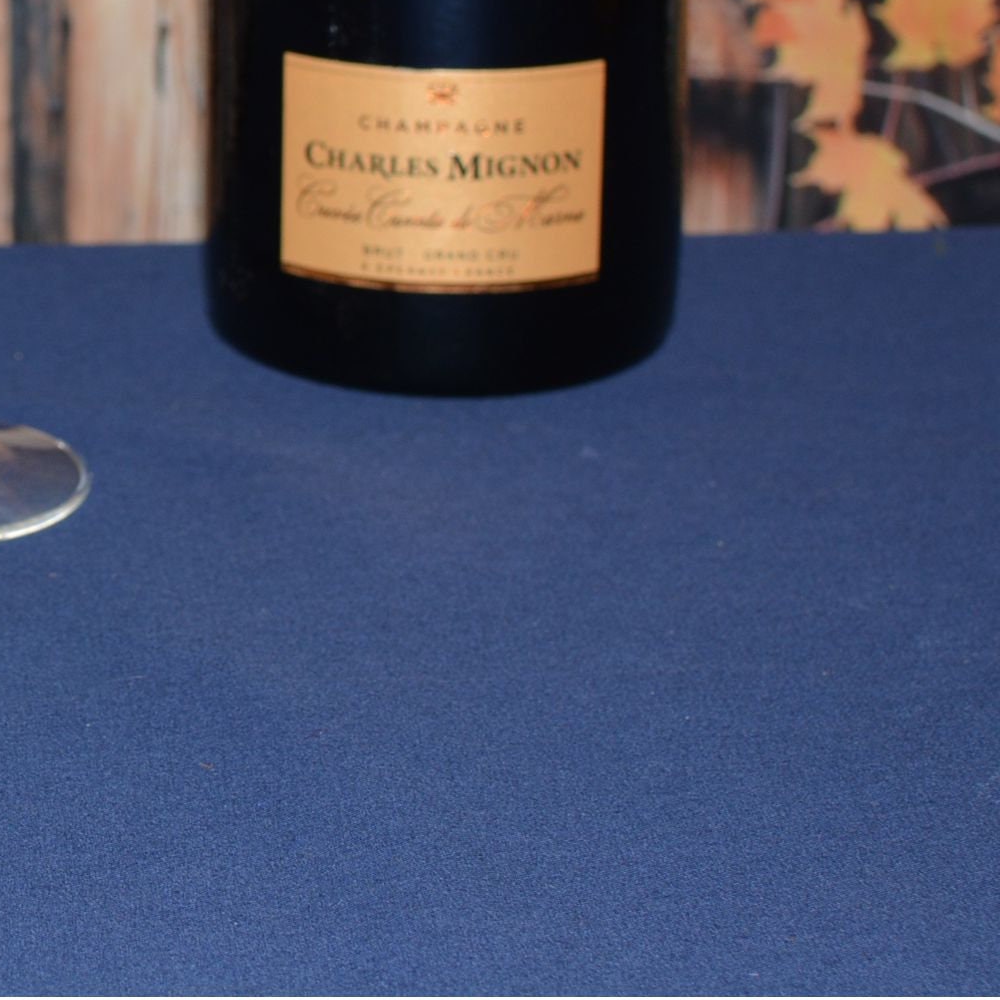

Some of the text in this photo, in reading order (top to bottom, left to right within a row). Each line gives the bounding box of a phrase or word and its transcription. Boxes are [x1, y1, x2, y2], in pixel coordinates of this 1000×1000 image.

[358, 114, 526, 135] CHAMPAGNE
[304, 140, 583, 181] CHARLES MIGNON
